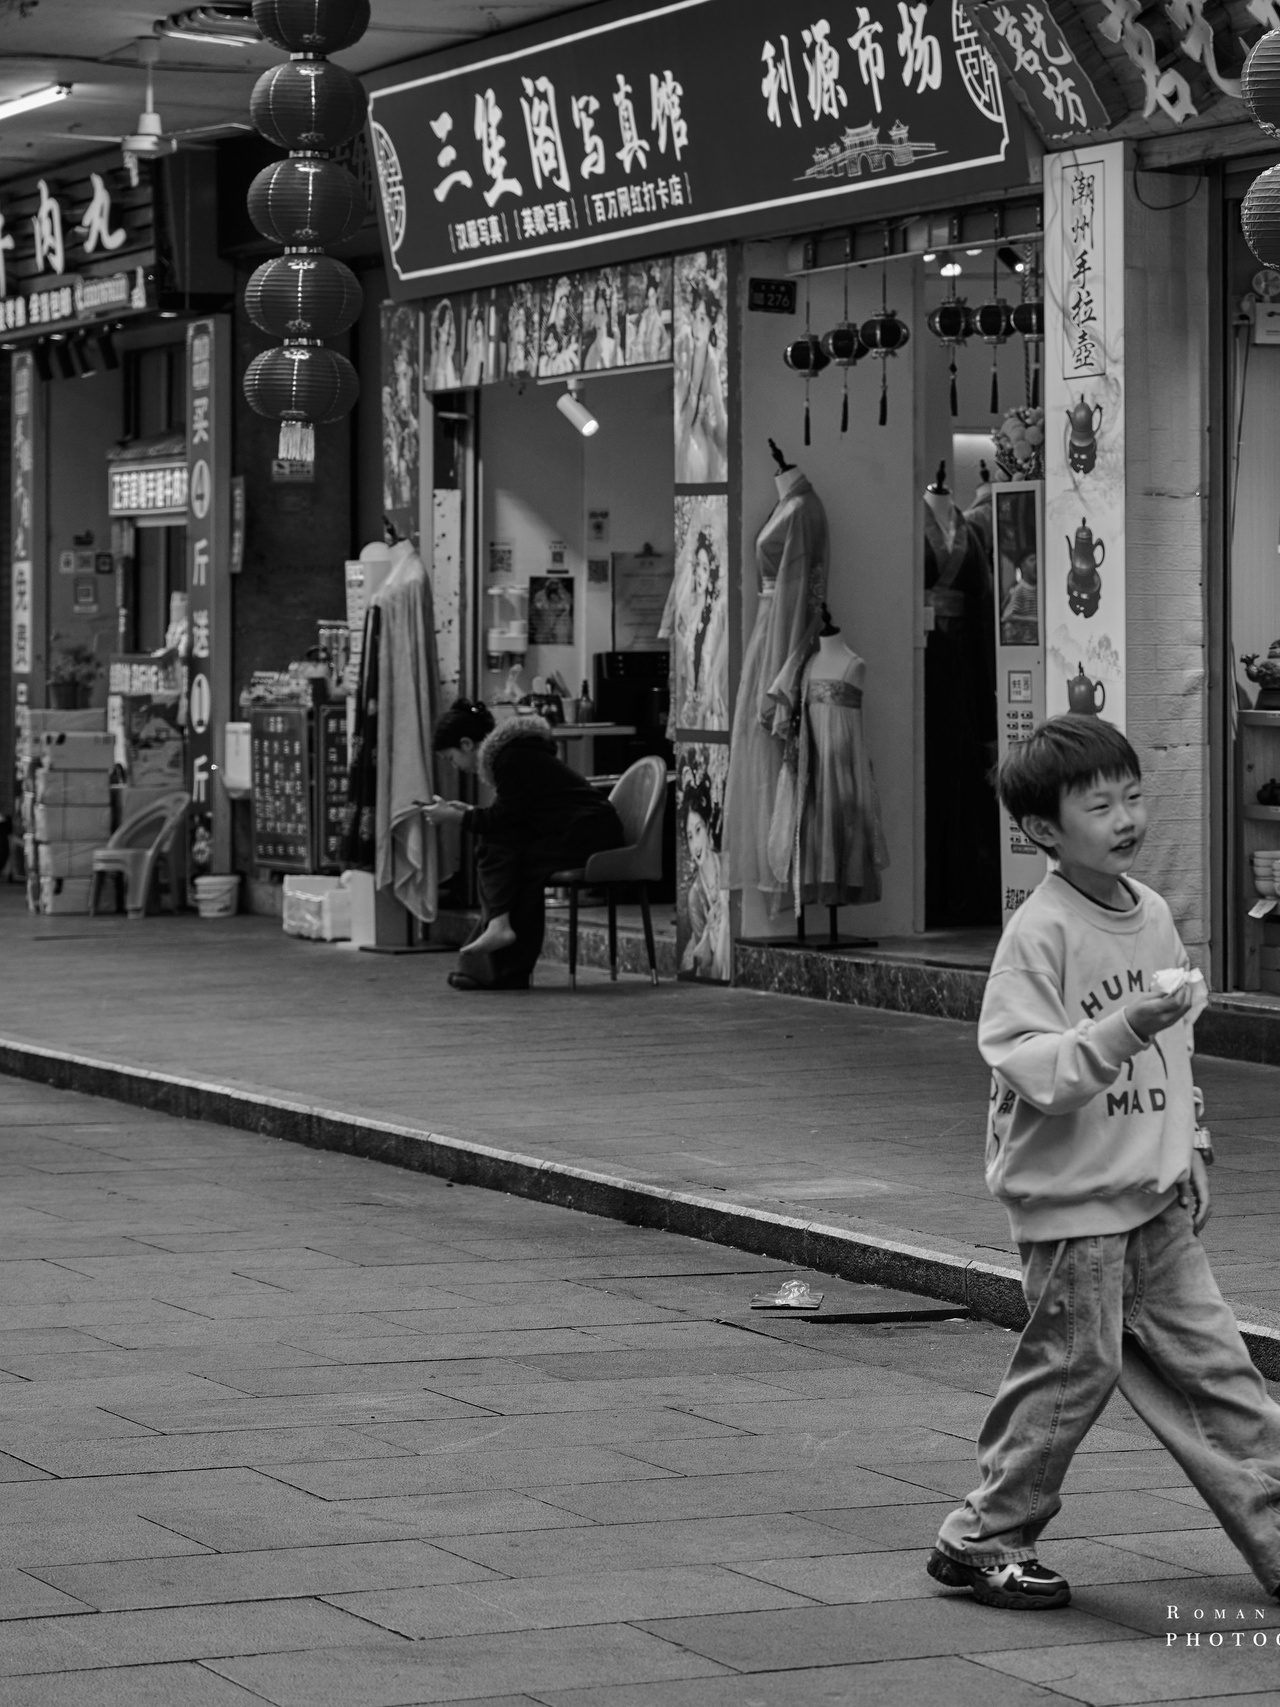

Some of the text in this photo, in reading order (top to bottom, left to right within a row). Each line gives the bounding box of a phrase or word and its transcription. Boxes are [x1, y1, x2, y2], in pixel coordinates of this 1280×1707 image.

[761, 2, 942, 128] 利源市场
[455, 215, 502, 251] 汉服写真
[591, 174, 683, 222] 百万网红打卡店
[767, 293, 791, 307] 276
[1004, 886, 1033, 910] 超级
[1080, 969, 1152, 1019] HUM
